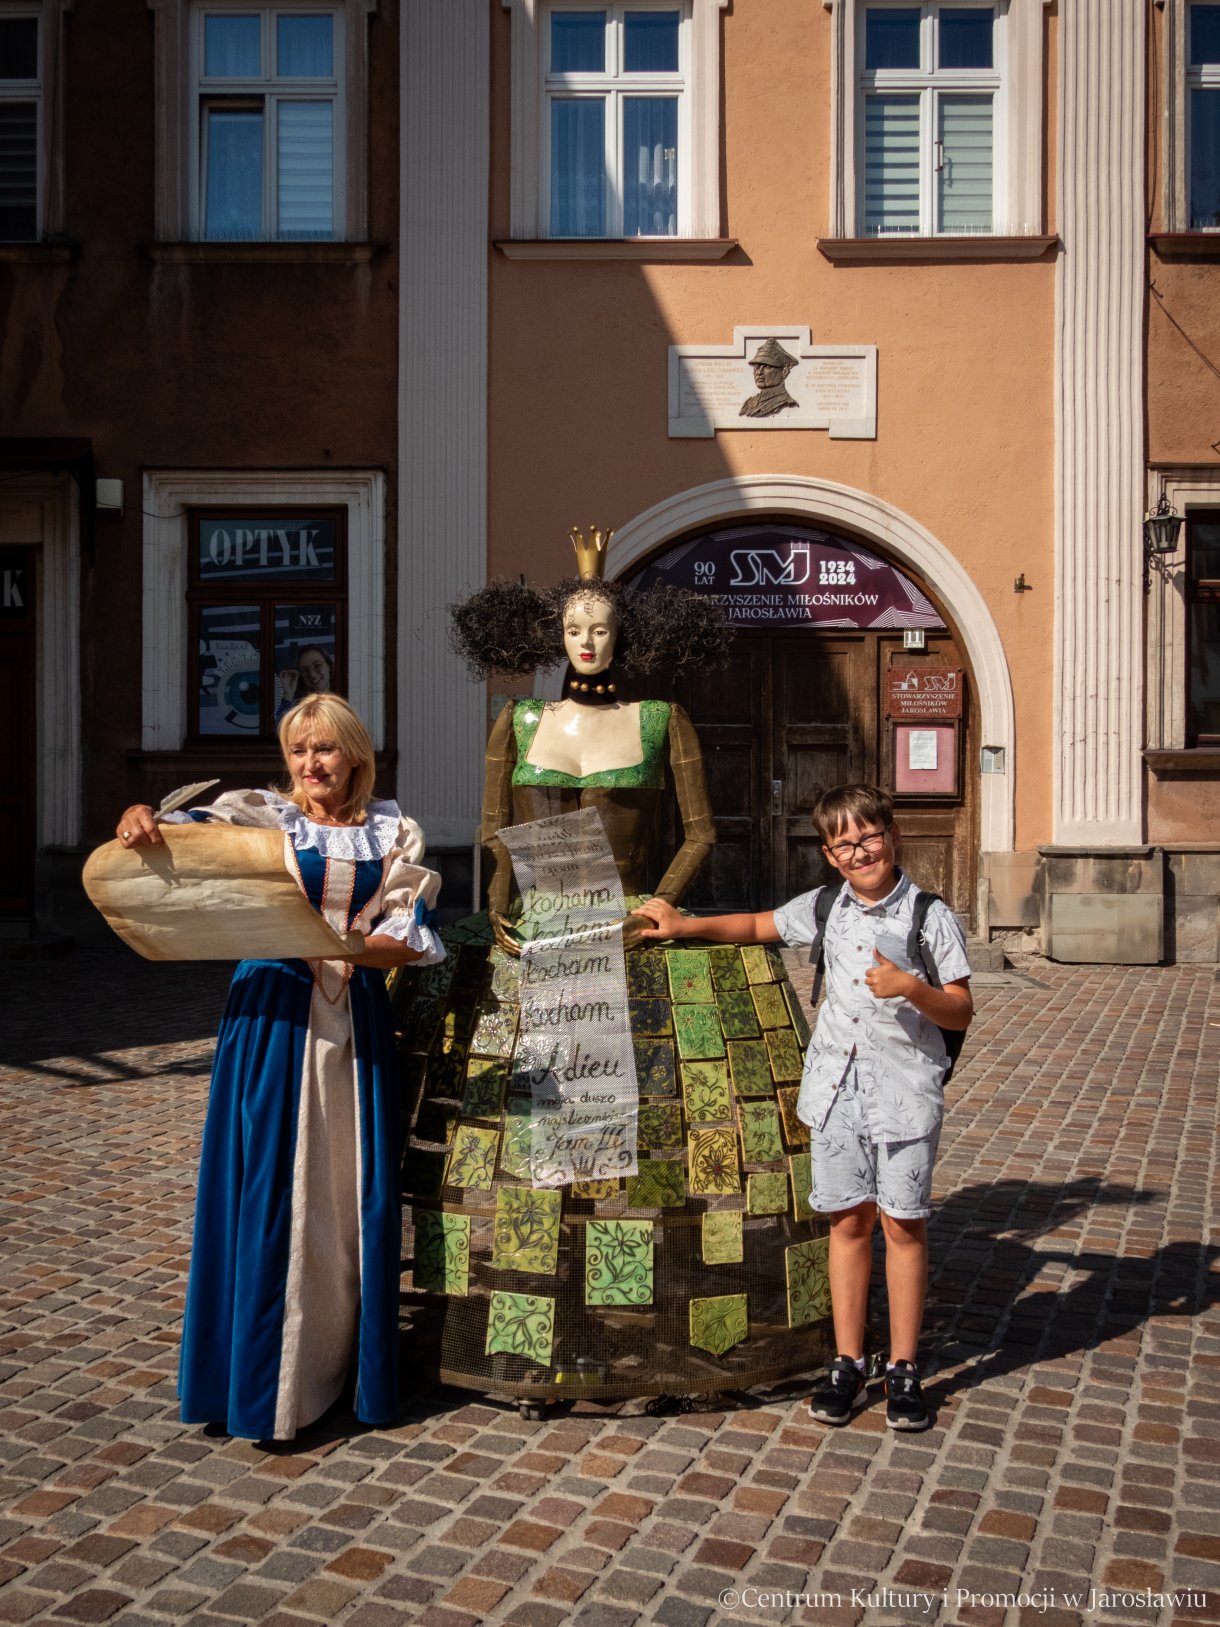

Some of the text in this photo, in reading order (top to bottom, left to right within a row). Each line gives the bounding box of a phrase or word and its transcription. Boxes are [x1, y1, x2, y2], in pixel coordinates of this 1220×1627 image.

[209, 528, 321, 566] OPTYK
[694, 562, 715, 576] 90
[819, 560, 855, 573] 1934
[694, 576, 715, 585] LAT
[819, 572, 856, 585] 2024
[788, 592, 879, 606] MIŁOŚNIKÓW
[728, 607, 812, 620] JAROSŁAWIA
[905, 631, 922, 644] 11
[531, 1042, 626, 1085] Adieu
[580, 1091, 616, 1104] duszo
